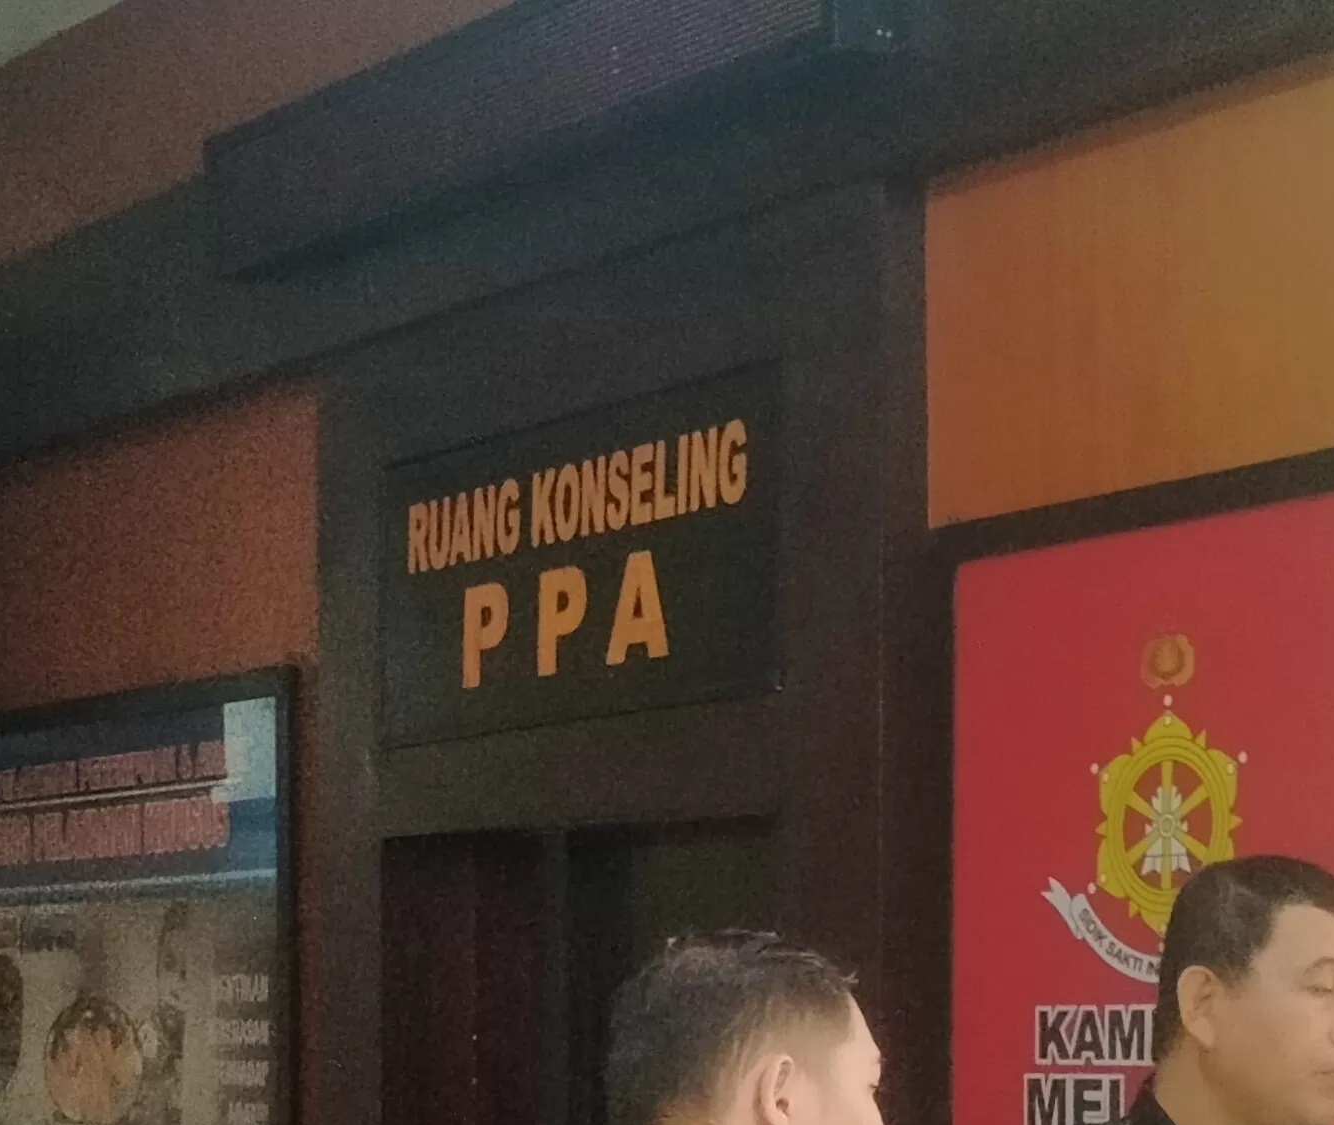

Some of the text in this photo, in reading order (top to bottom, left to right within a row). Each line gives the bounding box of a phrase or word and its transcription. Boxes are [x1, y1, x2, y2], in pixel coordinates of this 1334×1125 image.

[407, 418, 748, 575] RUANG KONSELING
[1105, 941, 1144, 973] SAKTI
[1035, 1004, 1156, 1066] KAM
